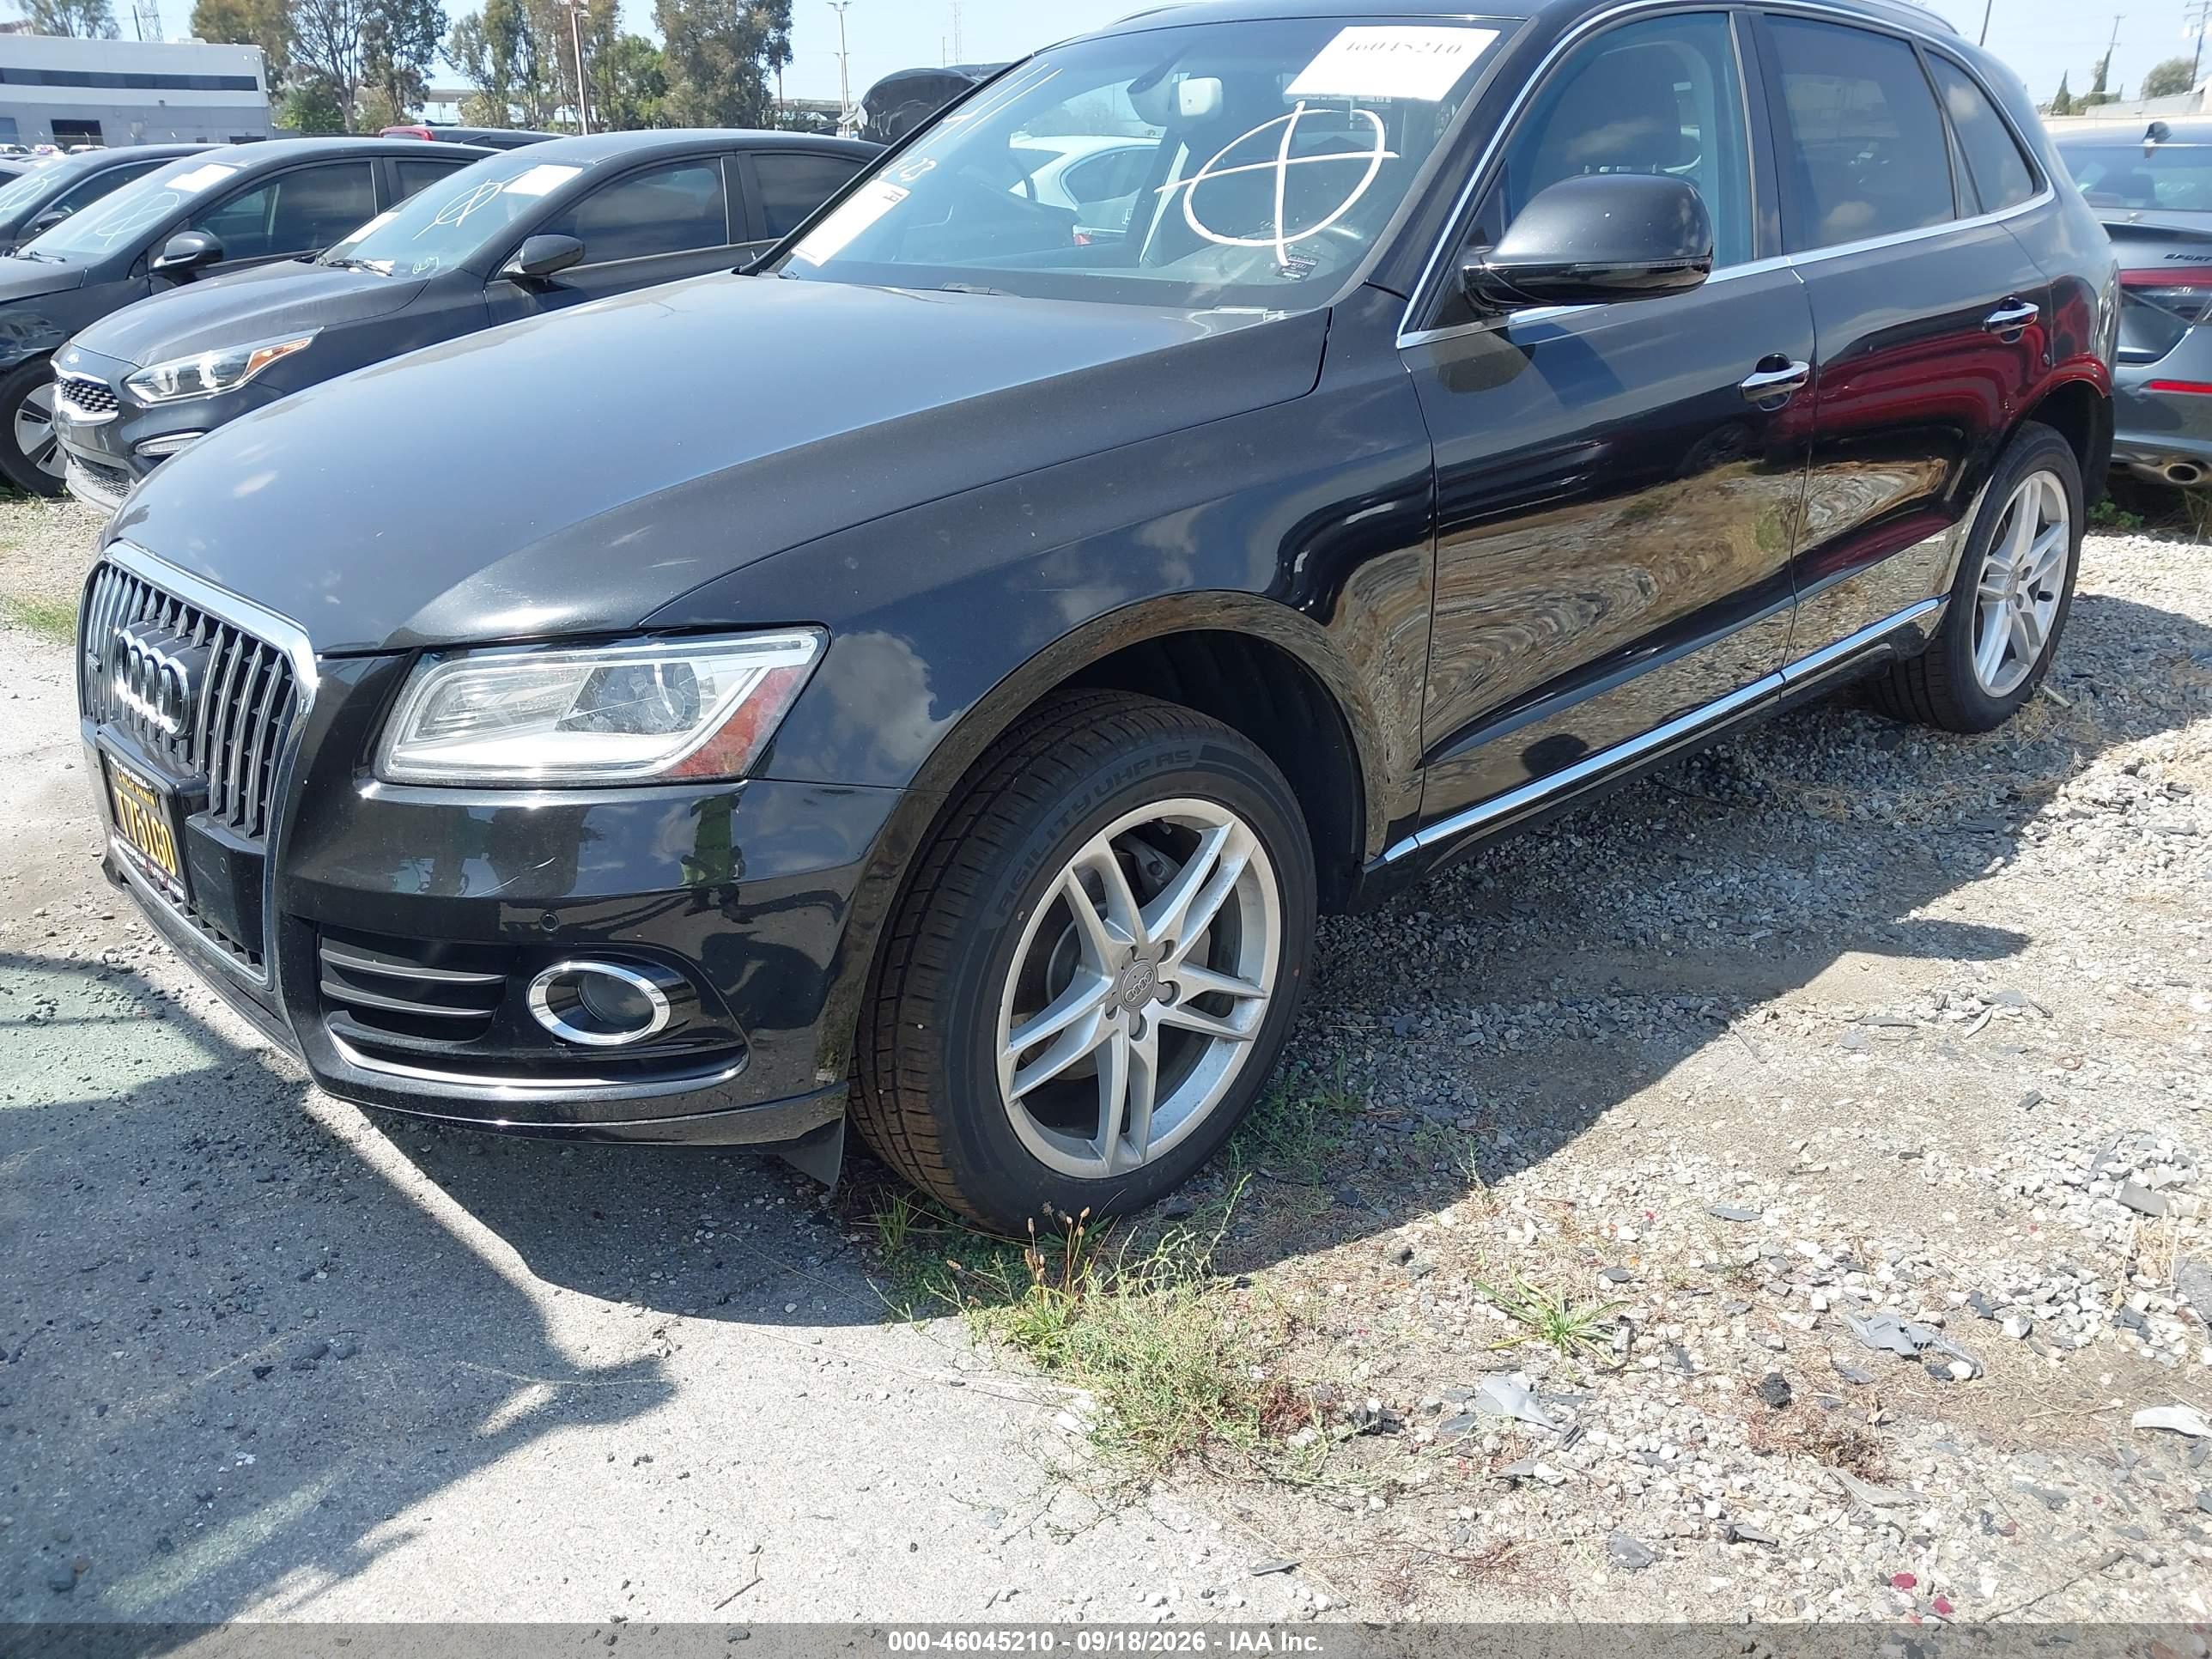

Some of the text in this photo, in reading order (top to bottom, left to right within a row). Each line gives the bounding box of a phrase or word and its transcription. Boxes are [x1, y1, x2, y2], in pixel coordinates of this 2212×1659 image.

[2163, 253, 2212, 262] SPORT
[998, 749, 1193, 915] AGILITY UHP AS
